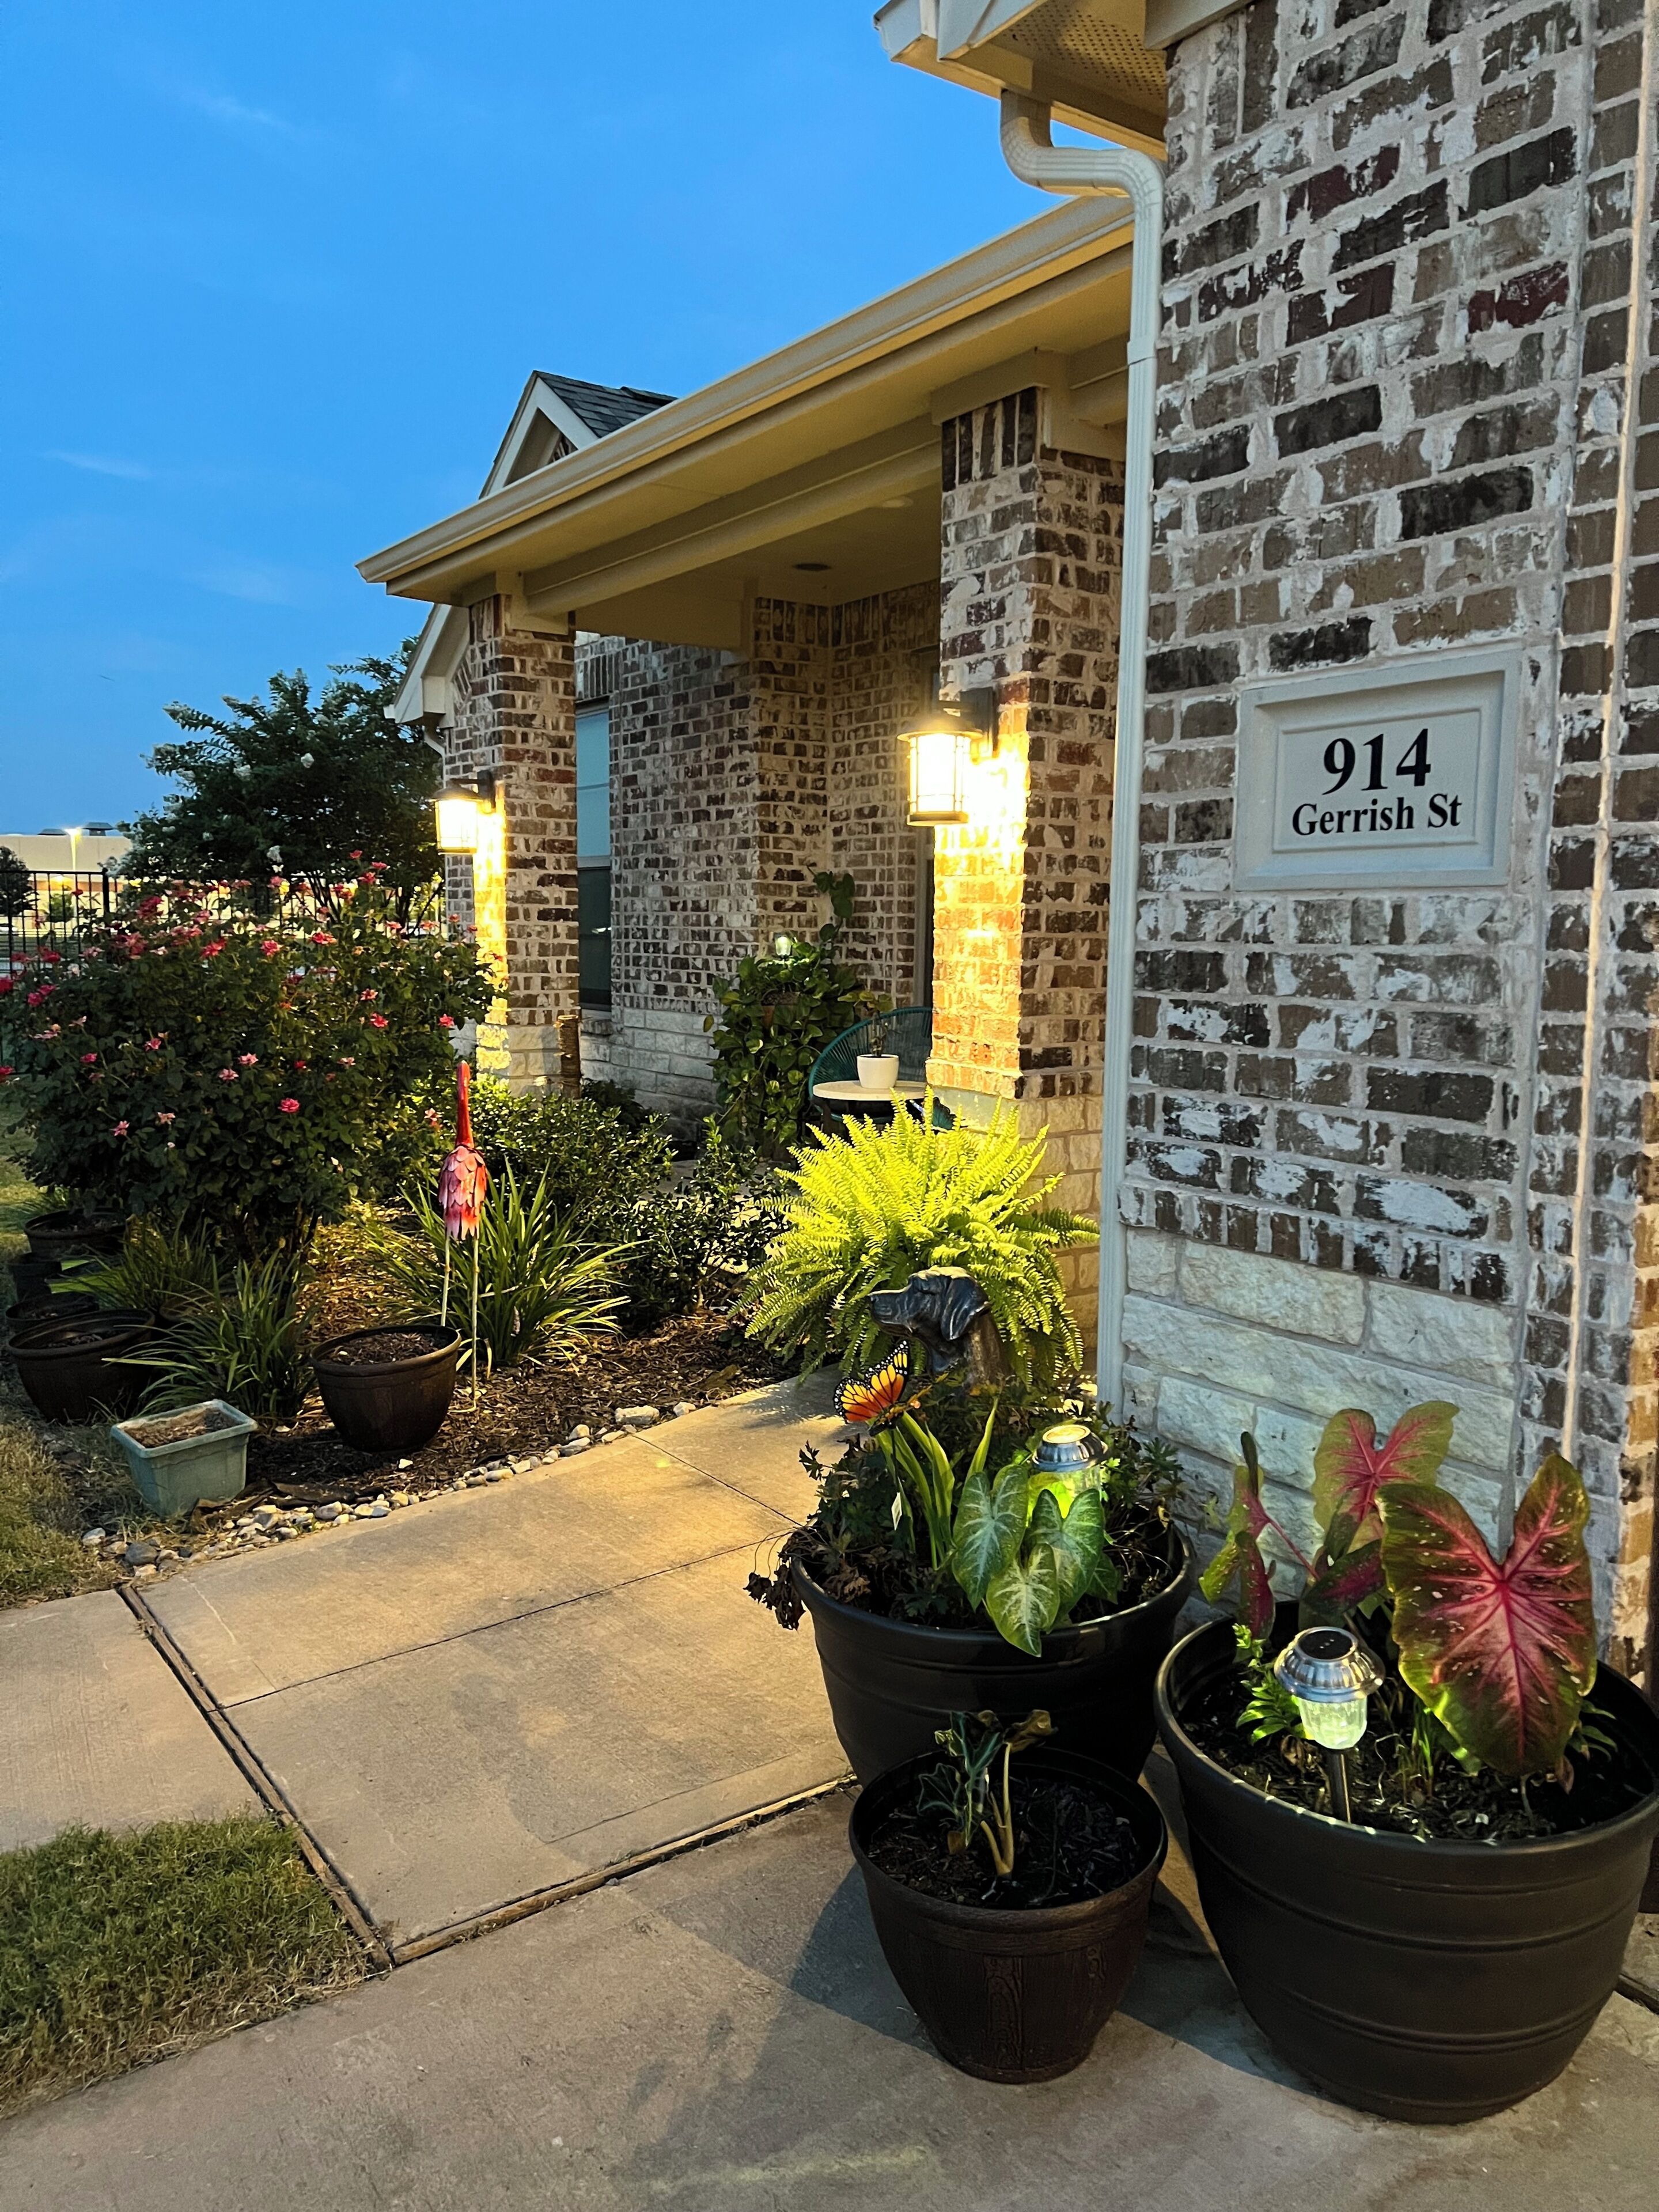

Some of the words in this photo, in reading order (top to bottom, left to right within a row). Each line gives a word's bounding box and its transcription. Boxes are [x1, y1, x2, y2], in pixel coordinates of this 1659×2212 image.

[1322, 729, 1431, 795] 914
[1293, 797, 1415, 836] Gerrish
[1427, 793, 1463, 828] St
